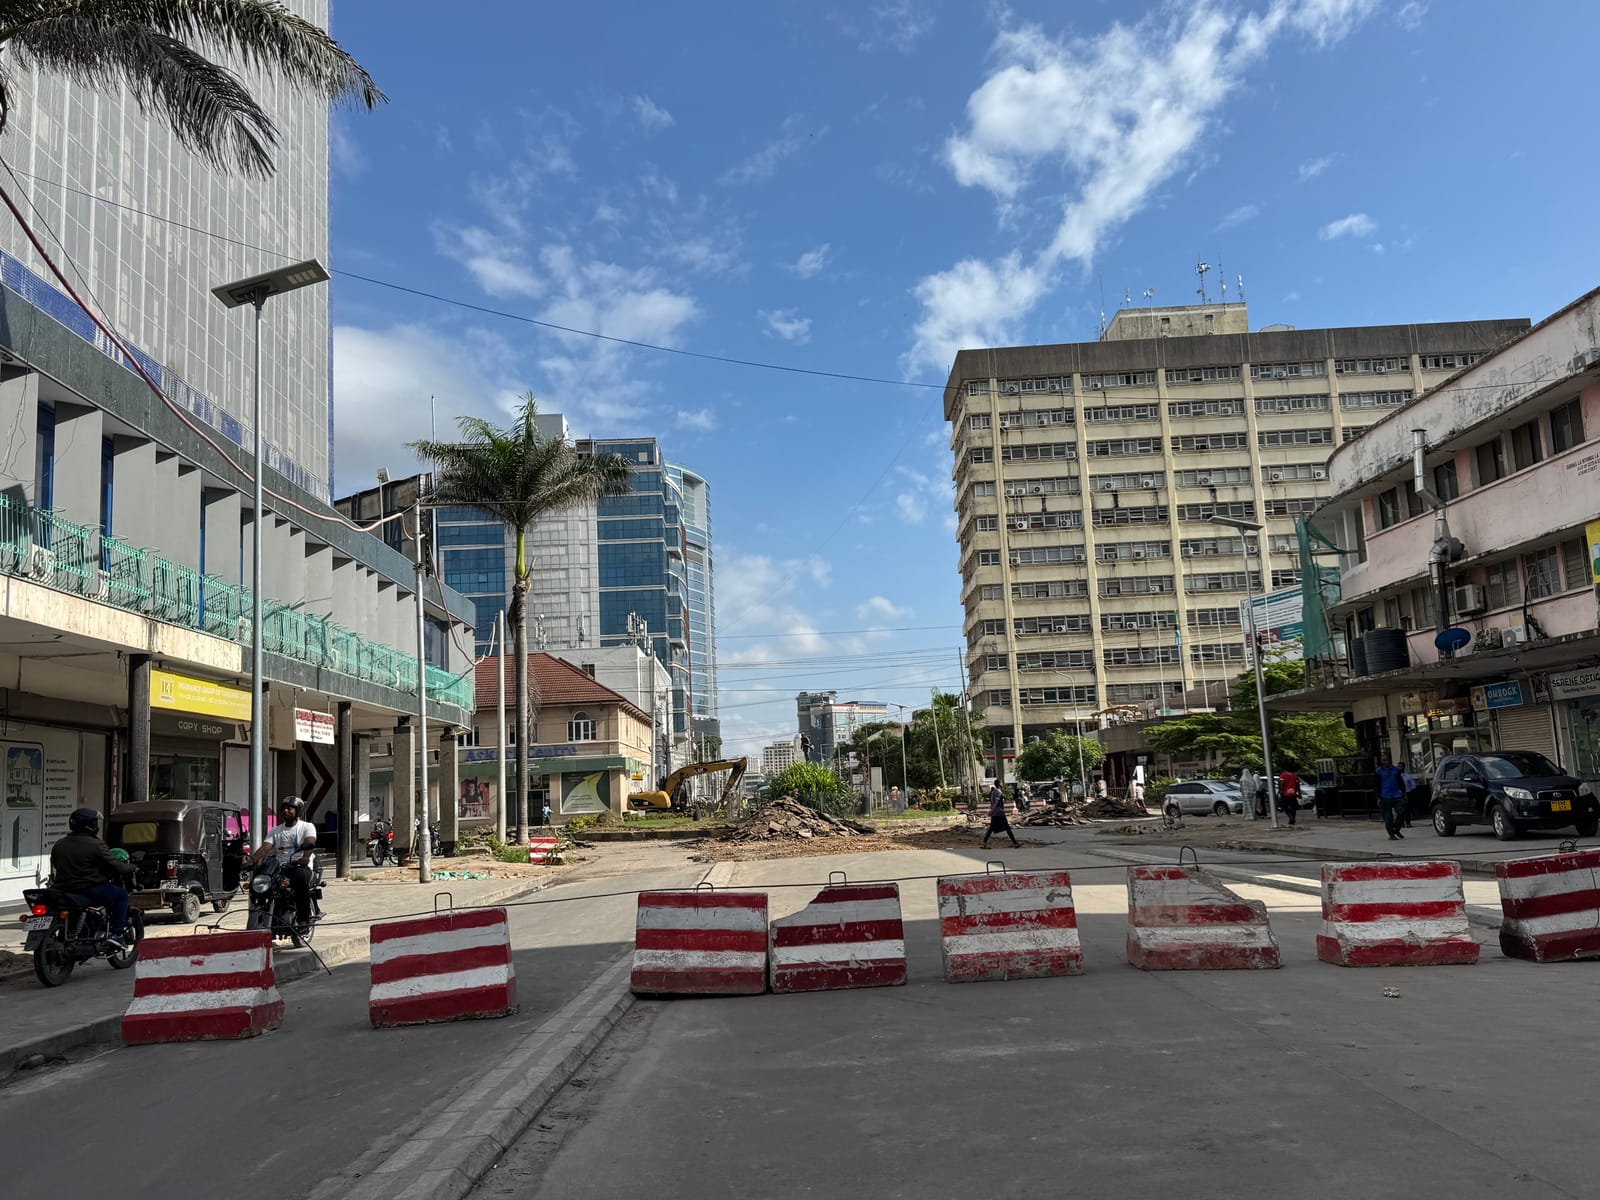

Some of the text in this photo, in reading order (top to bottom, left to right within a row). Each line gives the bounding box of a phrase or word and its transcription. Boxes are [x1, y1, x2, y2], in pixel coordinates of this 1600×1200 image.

[1552, 676, 1580, 689] SERENE
[178, 720, 222, 734] COPY SHOP
